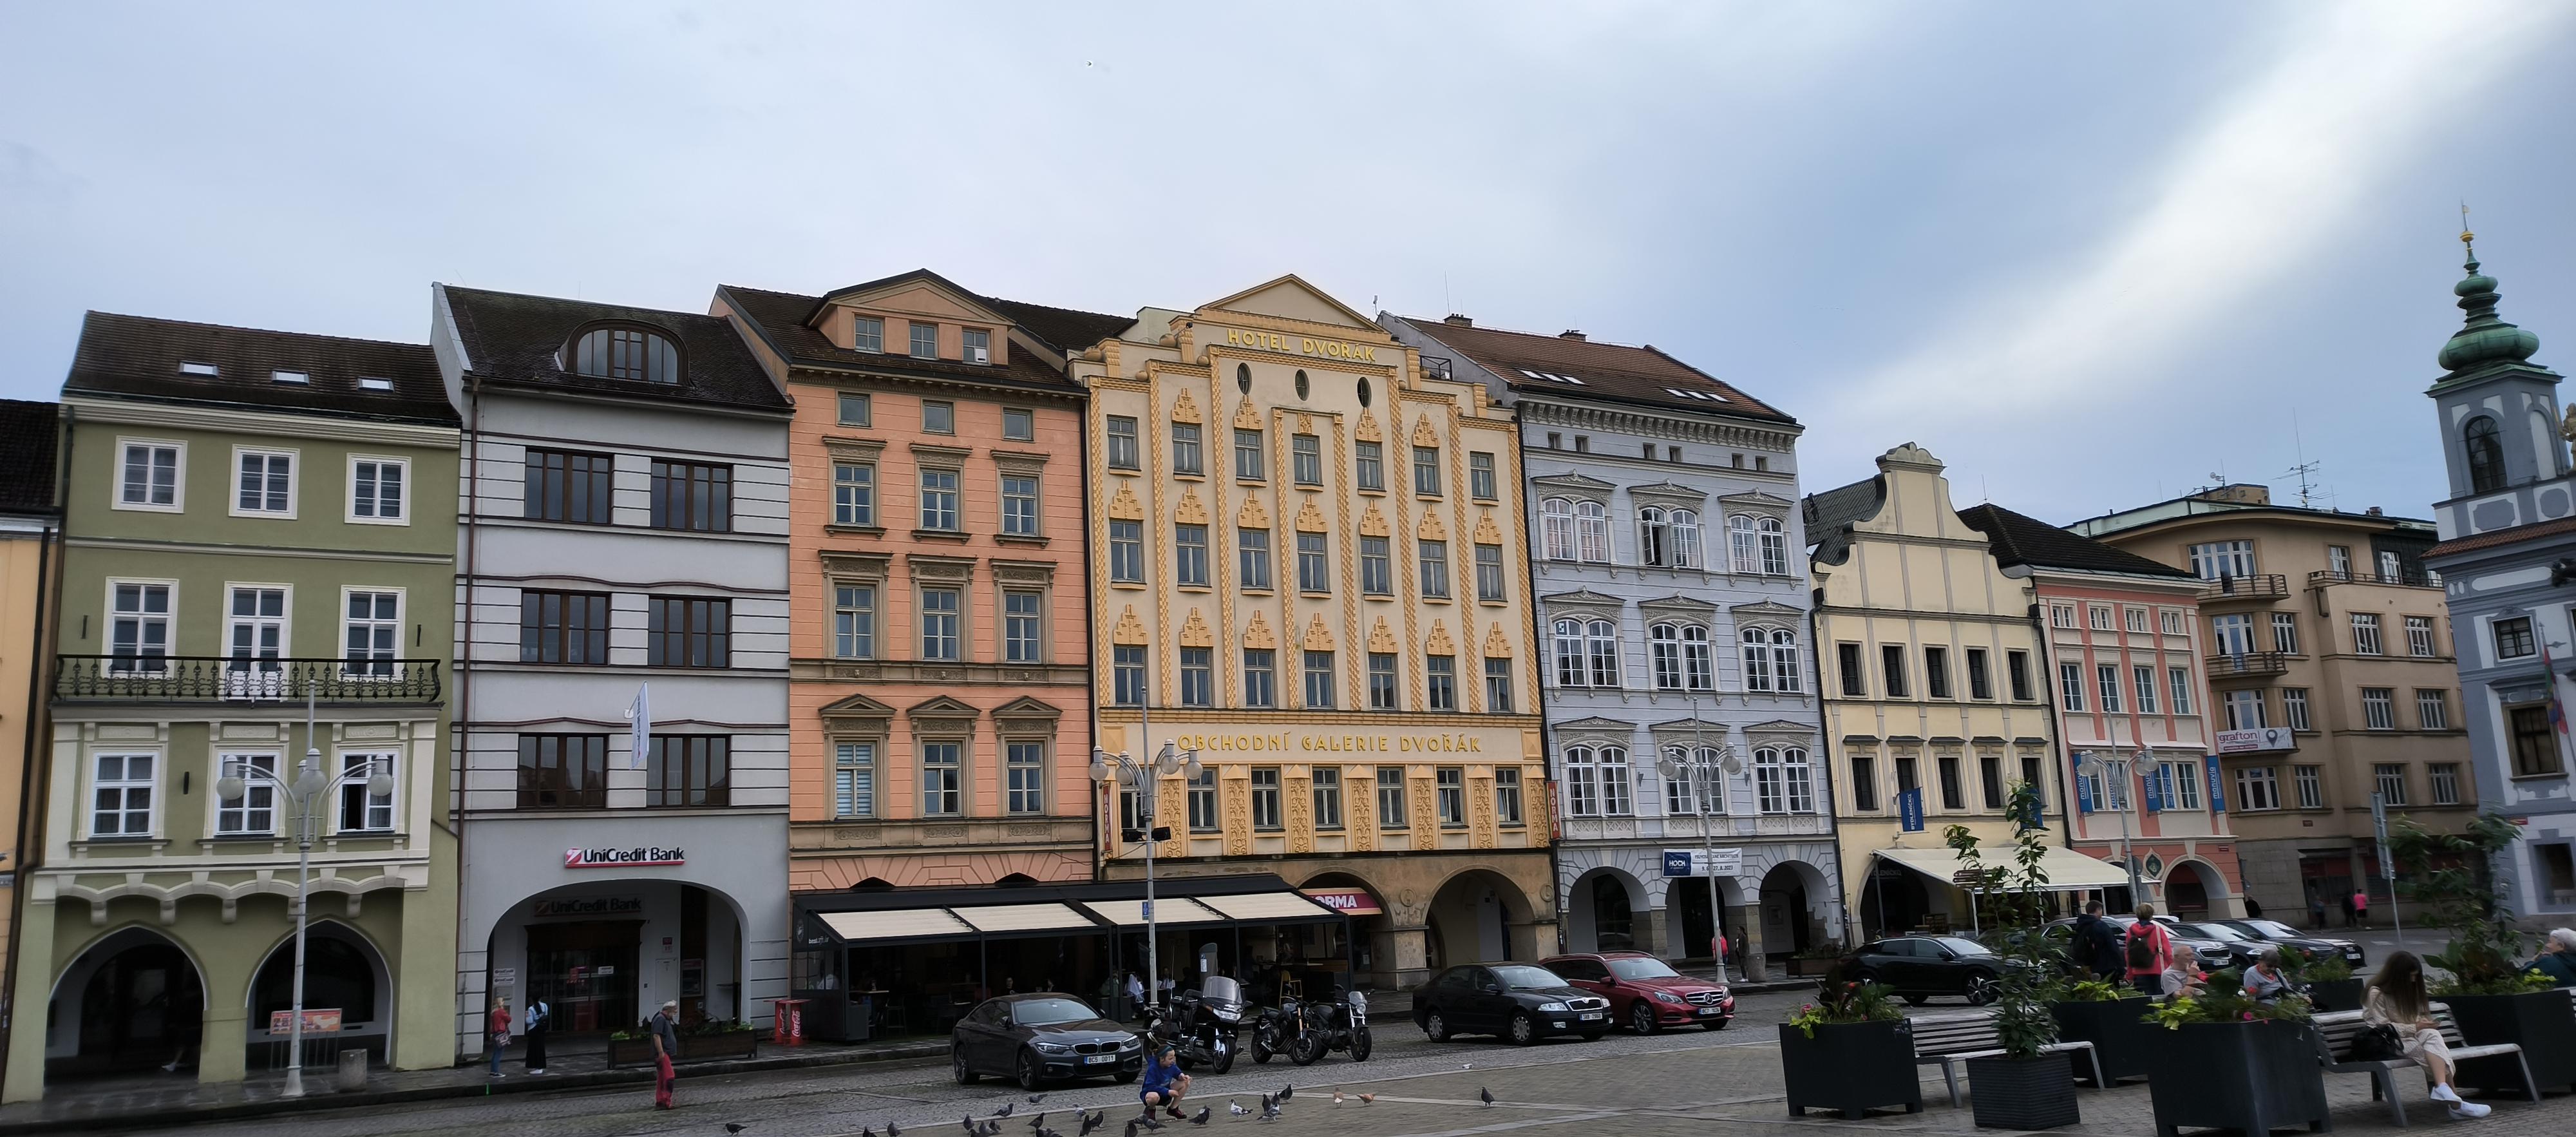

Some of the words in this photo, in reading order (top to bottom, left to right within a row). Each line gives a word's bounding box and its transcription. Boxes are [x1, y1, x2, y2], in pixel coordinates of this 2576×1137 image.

[1227, 329, 1290, 350] HOTEL
[1302, 338, 1376, 361] DVOŘÁK
[1177, 731, 1291, 752] OBCHODNÍ
[1302, 735, 1388, 752] GALERIE
[1400, 733, 1482, 753] DVOŘÁK
[2219, 731, 2258, 743] grafton
[2076, 771, 2086, 800] manuv
[2145, 772, 2154, 799] manuv
[2208, 767, 2219, 799] manuvia
[1549, 788, 1558, 832] NORMA
[583, 847, 647, 863] UniCredit
[650, 846, 685, 861] Bank
[551, 898, 609, 913] UniCredit
[611, 897, 641, 910] Bank
[1315, 895, 1358, 909] ORMA
[791, 1009, 800, 1037] Coca-Cola
